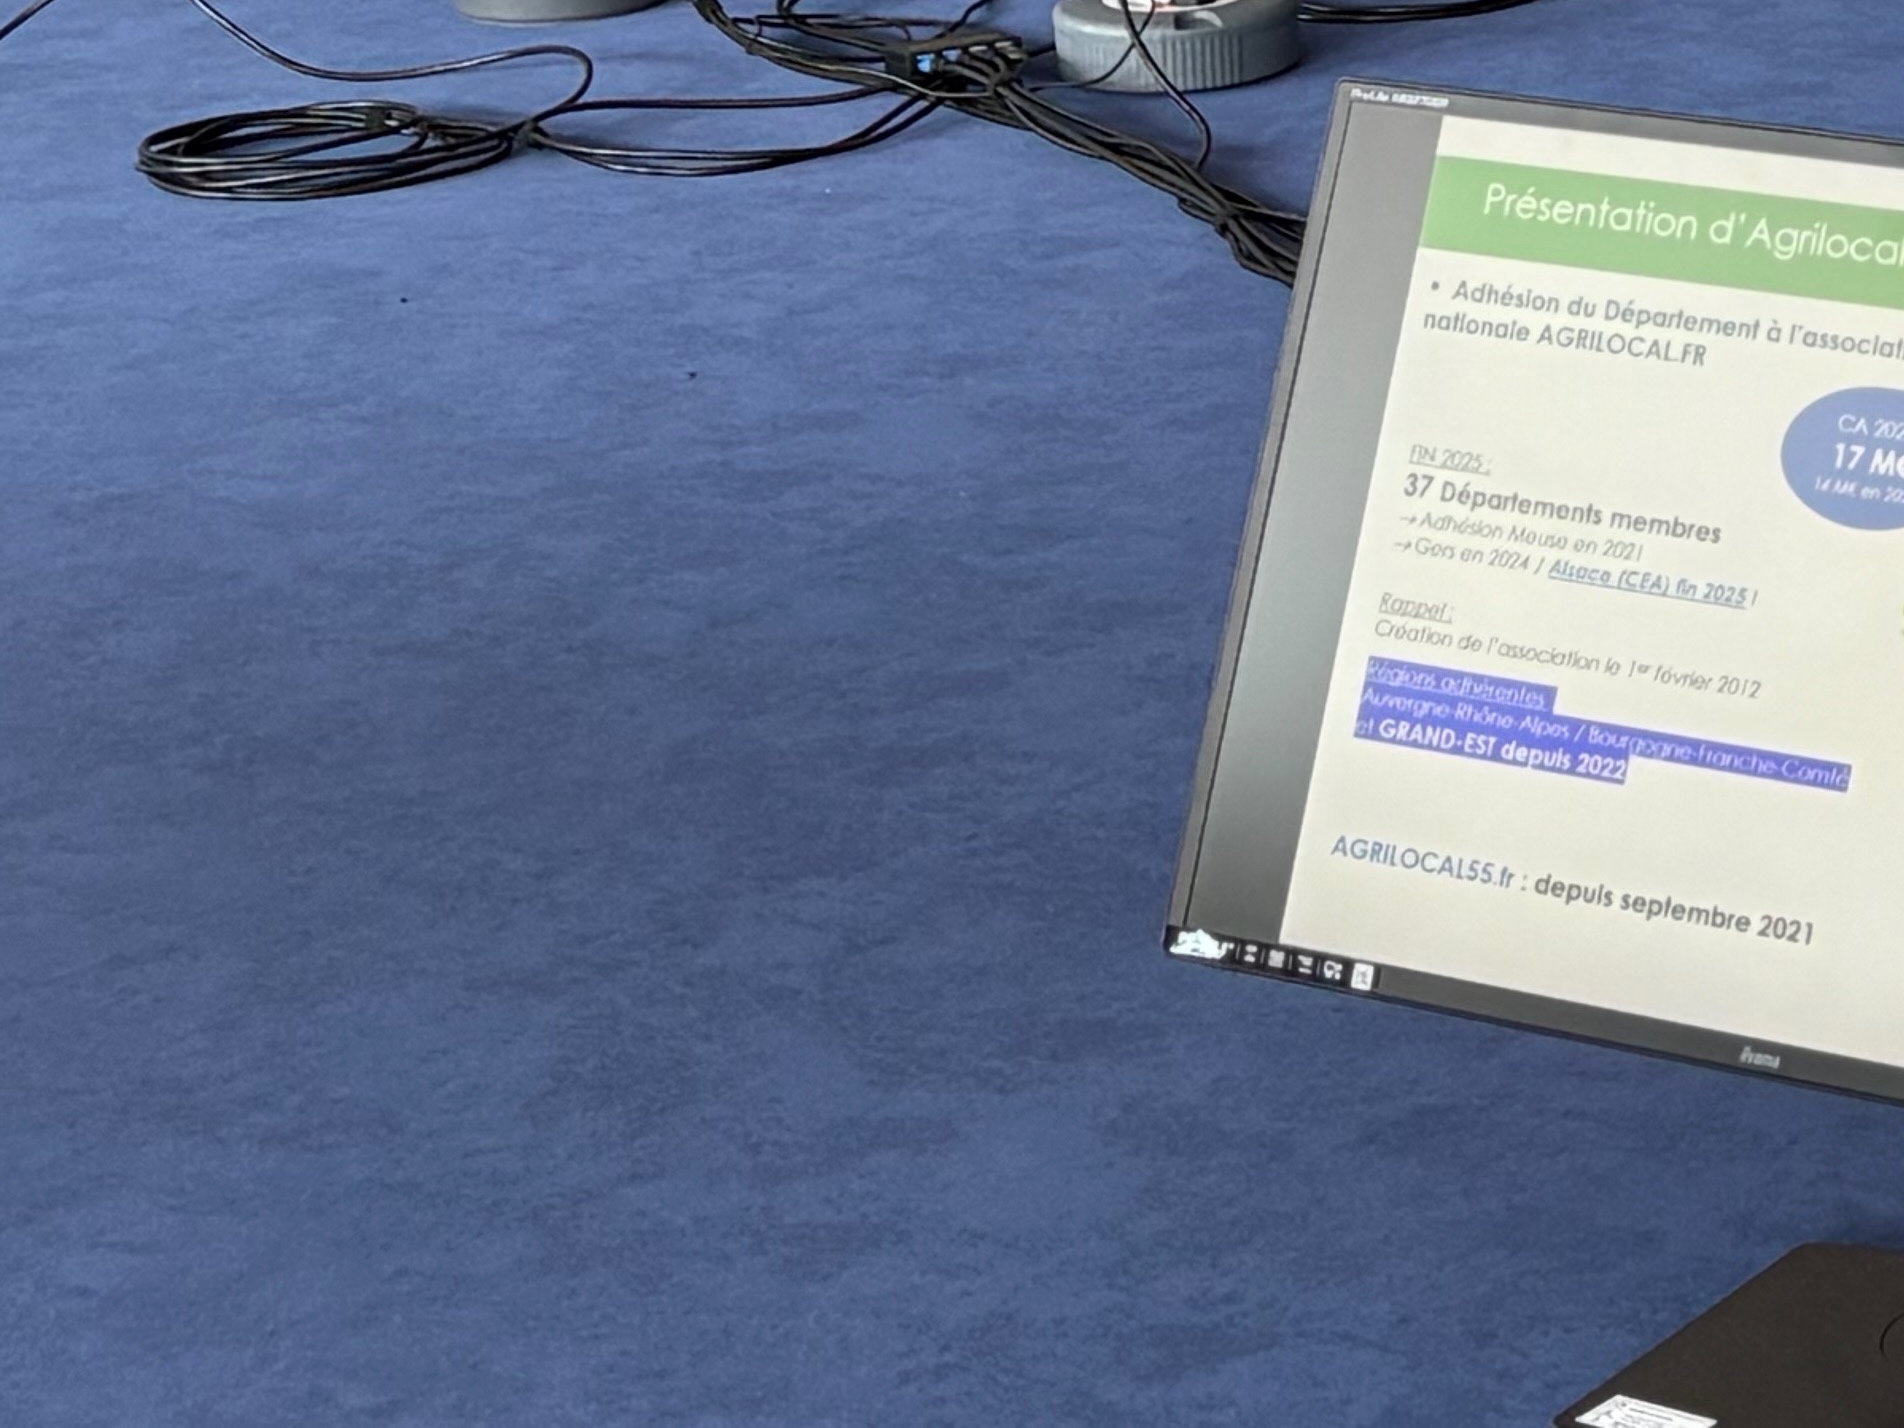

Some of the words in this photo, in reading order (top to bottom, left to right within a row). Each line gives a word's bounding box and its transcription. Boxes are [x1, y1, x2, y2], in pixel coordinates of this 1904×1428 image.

[1482, 181, 1699, 240] Présentation
[1422, 309, 1531, 342] nationale
[1536, 323, 1707, 367] AGRILOCAL.FR
[1450, 278, 1561, 314] Adhésion
[1566, 295, 1597, 319] du
[1603, 297, 1760, 343] Département
[1837, 413, 1869, 435] CA
[1833, 442, 1866, 471] 17
[1402, 472, 1434, 499] 37
[1438, 479, 1604, 528] Départements
[1609, 509, 1722, 544] membres
[1616, 567, 1671, 596] (CEA)
[1702, 581, 1748, 605] 2025
[1456, 633, 1483, 652] de
[1716, 674, 1762, 699] 2012
[1377, 717, 1497, 757] GRAND-EST
[1498, 737, 1573, 775] depuis
[1575, 752, 1626, 779] 2022
[1330, 834, 1515, 888] AGRILOCAL55.fr
[1533, 872, 1614, 910] depuis
[1618, 890, 1752, 936] septembre
[1756, 914, 1814, 945] 2021
